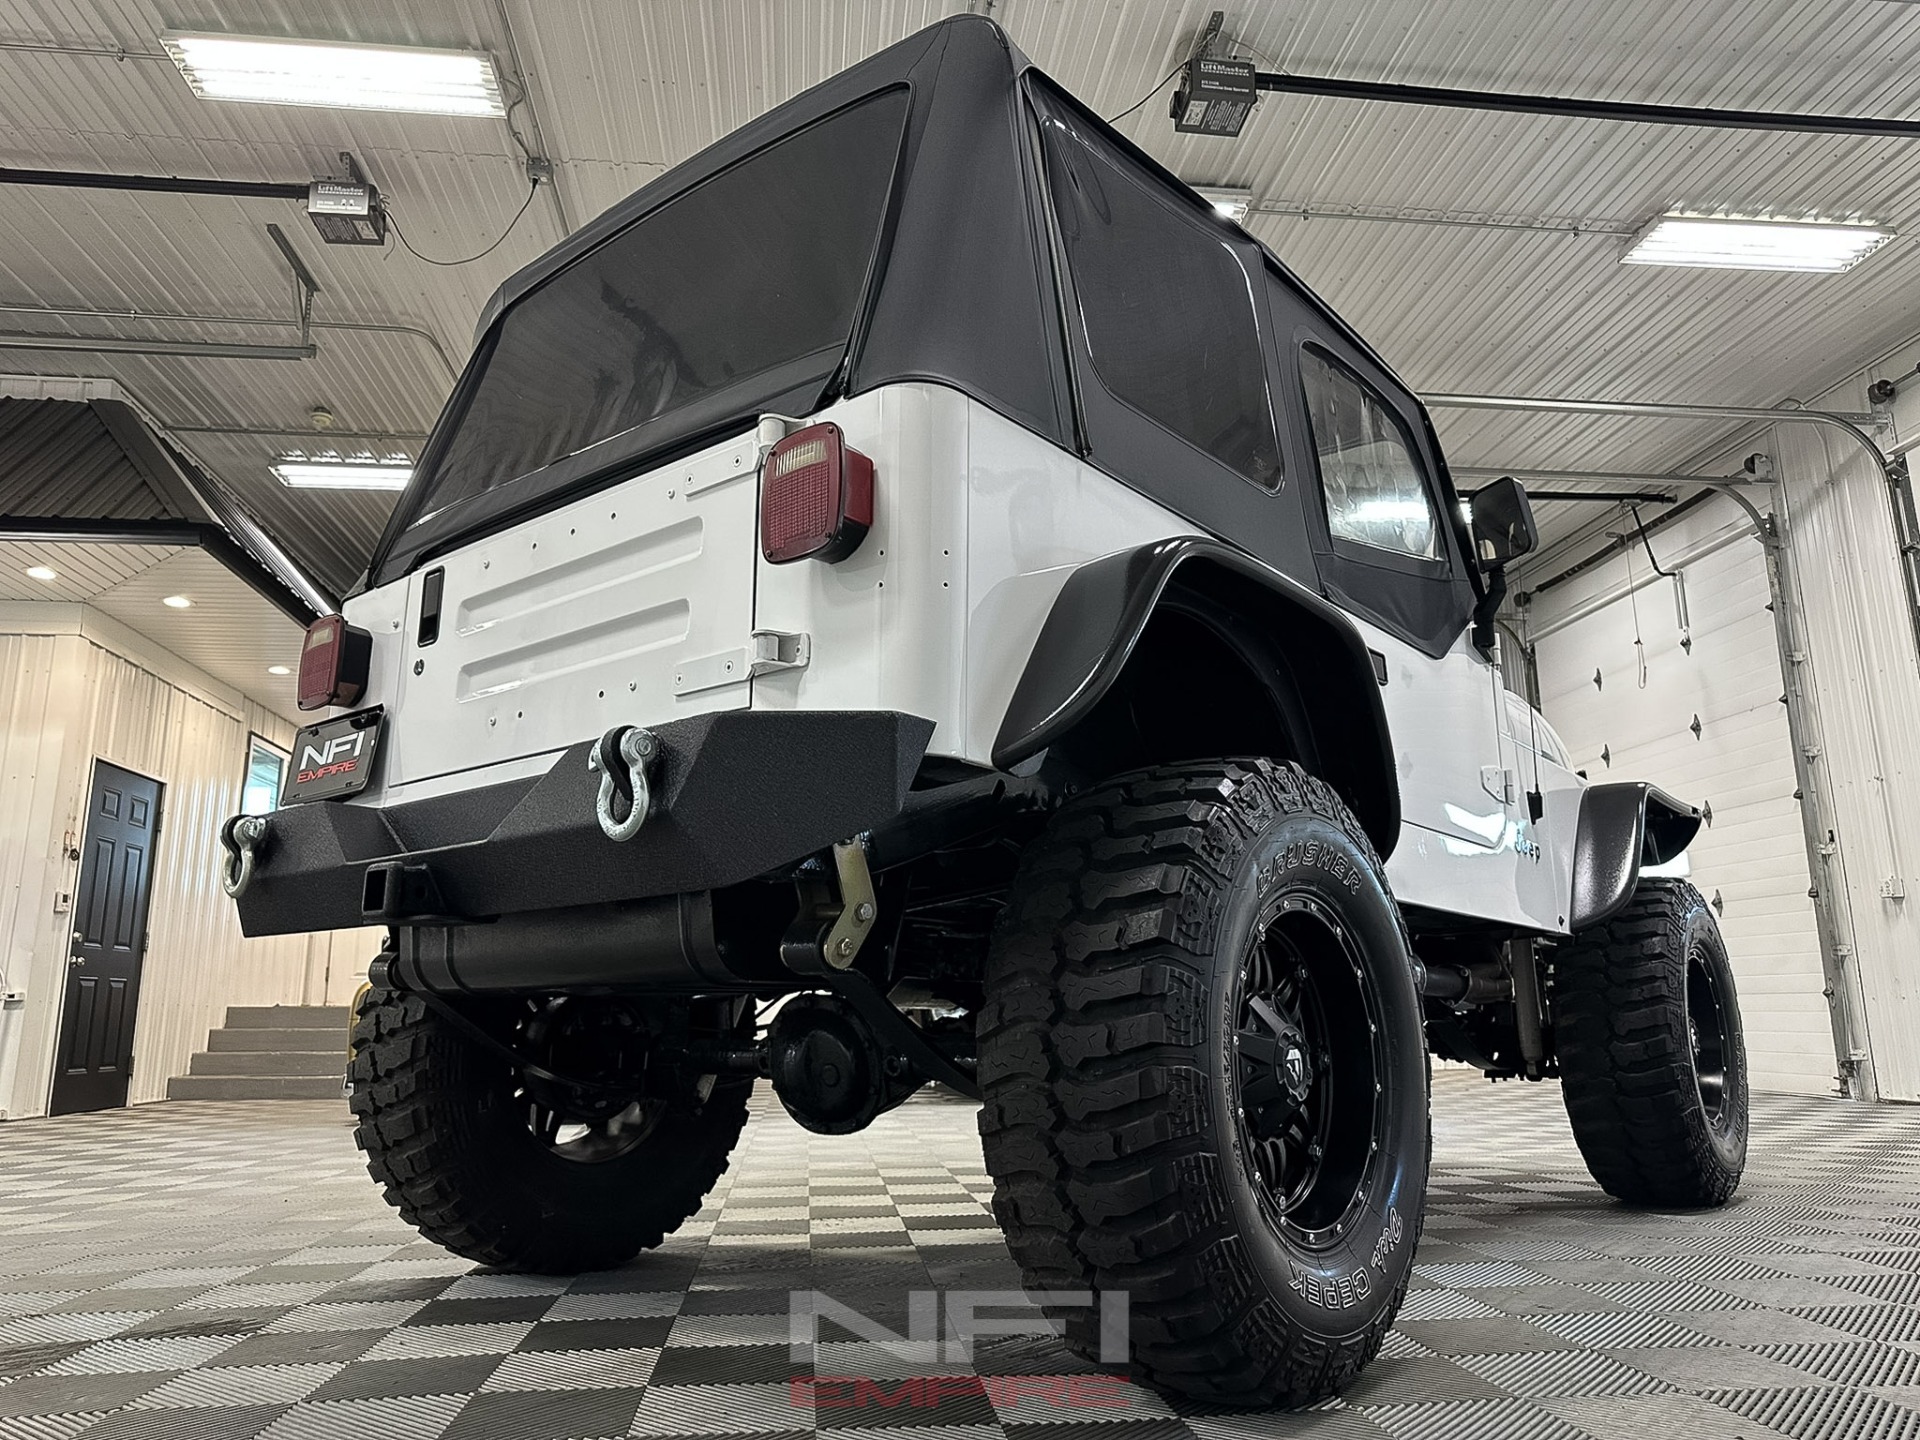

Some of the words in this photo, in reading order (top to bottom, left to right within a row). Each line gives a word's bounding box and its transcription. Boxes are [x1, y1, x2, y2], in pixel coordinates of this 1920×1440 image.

[1200, 62, 1249, 74] LiftMaster
[318, 185, 364, 194] LiftMaster
[299, 731, 365, 771] NFI
[297, 759, 358, 784] EMPIRE
[1515, 828, 1540, 864] Jeep
[1257, 839, 1362, 898] CRUSHER
[1288, 1259, 1371, 1310] CEPEK
